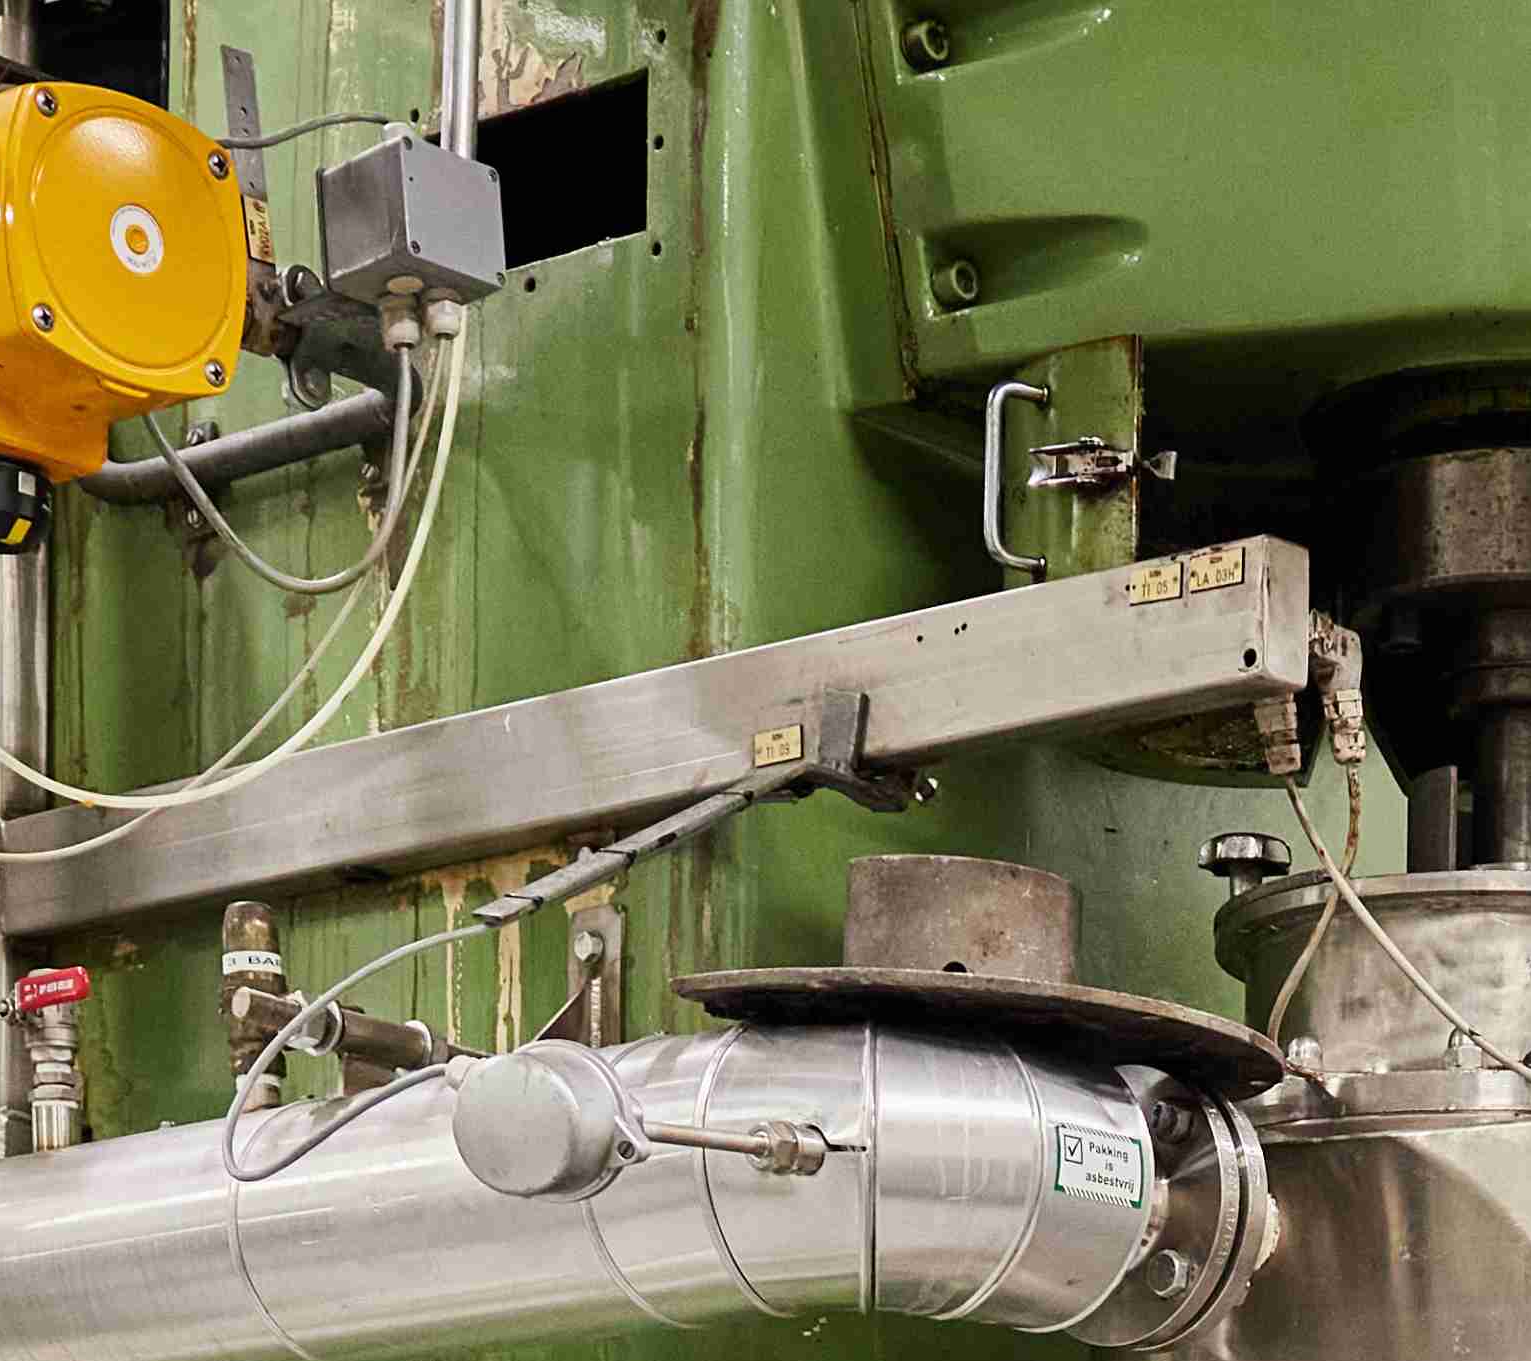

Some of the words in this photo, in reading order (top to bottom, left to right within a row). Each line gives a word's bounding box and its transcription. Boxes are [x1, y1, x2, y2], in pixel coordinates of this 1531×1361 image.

[1088, 1141, 1129, 1163] Pakking
[1104, 1159, 1114, 1172] is
[1085, 1172, 1134, 1194] asbestvrij
